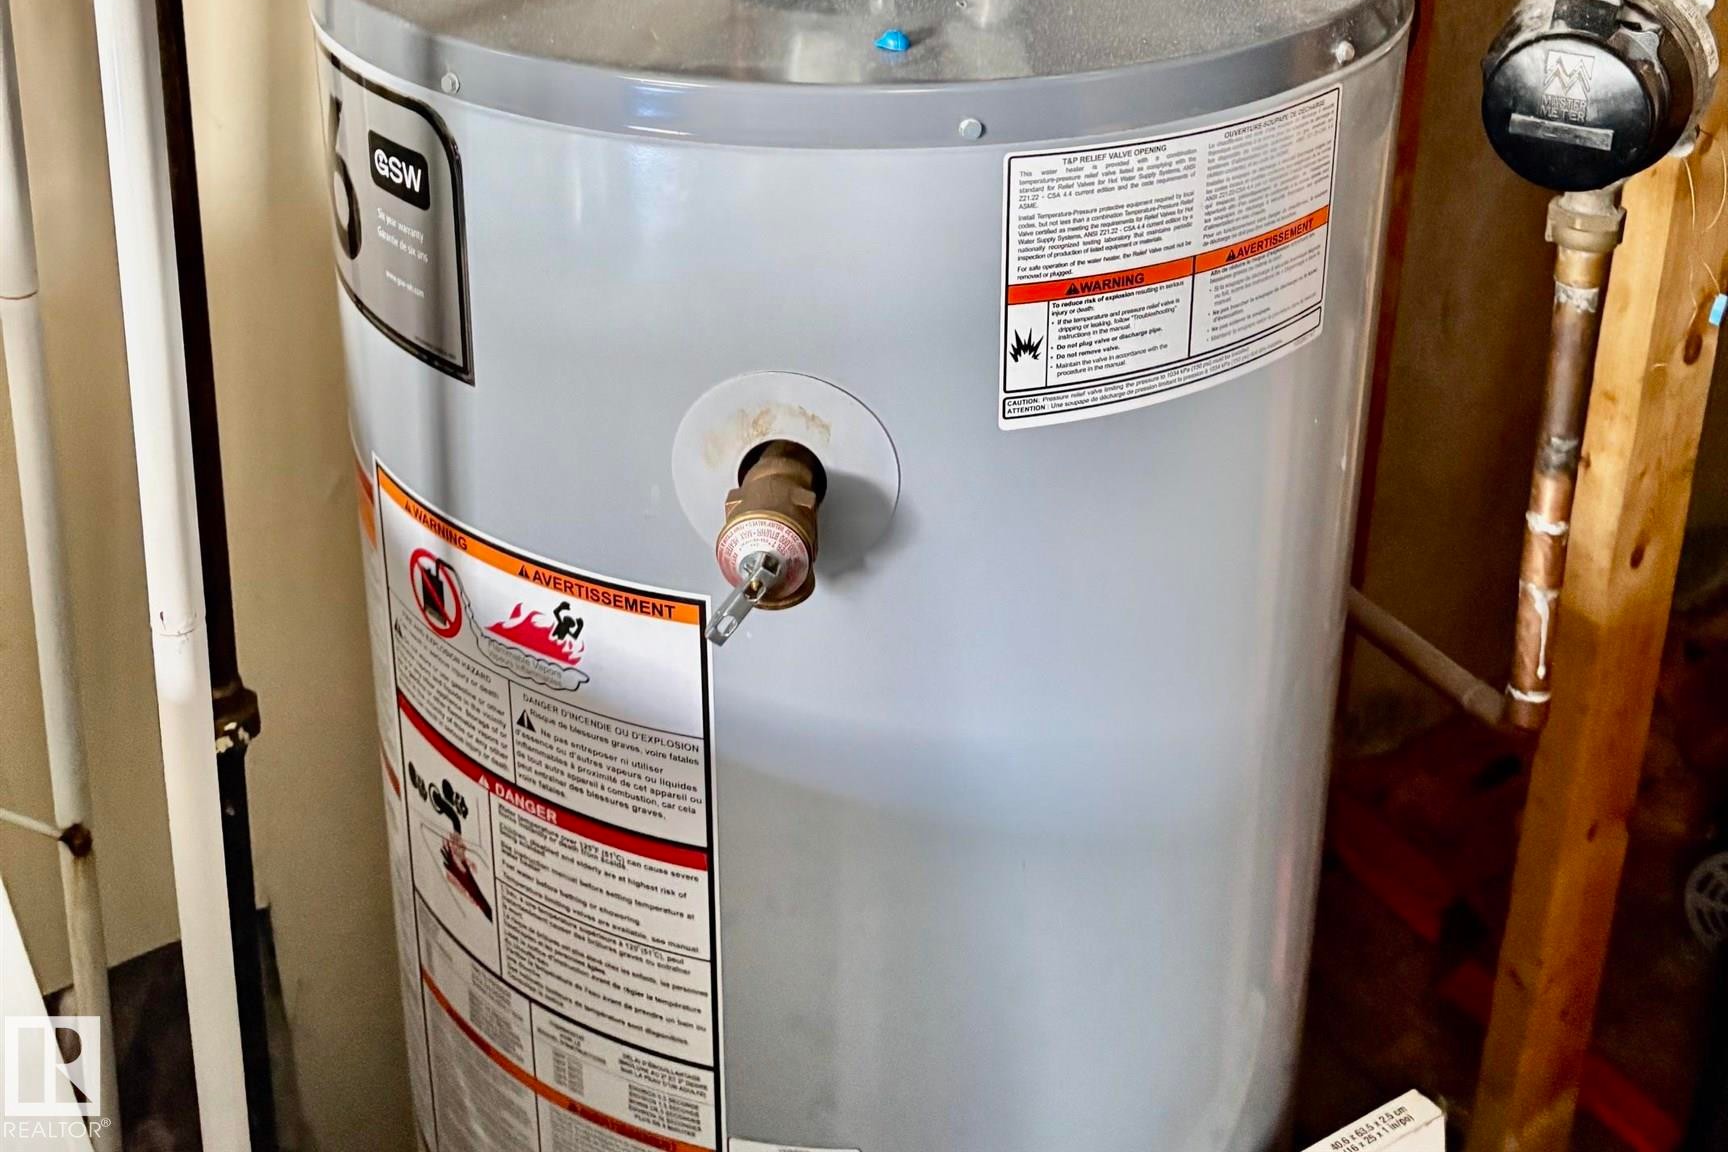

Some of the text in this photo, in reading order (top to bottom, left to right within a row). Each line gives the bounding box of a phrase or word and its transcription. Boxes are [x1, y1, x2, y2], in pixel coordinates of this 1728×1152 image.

[1542, 95, 1586, 110] MASTER
[1541, 105, 1585, 122] METER
[1062, 145, 1166, 165] T&P RELIEF VALVE OPENING
[374, 148, 422, 192] GSW
[398, 222, 424, 243] warranty
[1237, 219, 1314, 258] AVERTISSEMENT
[1018, 248, 1082, 261] inspection production
[1017, 269, 1073, 280] removed plugged.
[1042, 261, 1068, 270] operation
[1079, 274, 1144, 293] WARNING
[1105, 291, 1134, 301] explosion
[1136, 286, 1158, 295] resulting
[1058, 324, 1082, 333] dripping
[1091, 320, 1112, 328] leaking,
[1114, 316, 1130, 324] follow
[1131, 306, 1177, 320] "Troubleshooting"
[1073, 313, 1108, 323] temperature
[1122, 306, 1145, 315] pressure
[1058, 331, 1091, 340] instructions
[1079, 339, 1092, 347] plug
[1119, 330, 1147, 340] discharge
[1149, 327, 1162, 335] pipe.
[1056, 361, 1080, 369] Maintain
[1115, 348, 1146, 358] accordance
[1148, 345, 1159, 353] with
[1079, 348, 1100, 356] remove
[1057, 368, 1086, 377] procedure
[1042, 392, 1069, 401] Pressure
[1136, 377, 1159, 386] pressure
[1008, 405, 1045, 414] ATTENTION
[413, 507, 468, 550] WARNING
[532, 570, 675, 619] AVERTISSEMENT
[523, 693, 699, 752] DANGER D'INCENDIE OU D'EXPLOSION
[530, 709, 699, 766] Risque de blessures voire fatales
[515, 729, 697, 792] d'essence ou d'autres vapeurs ou liquides
[541, 728, 664, 774] Ne pas entreposer ni utiliser
[516, 739, 702, 804] inflammables proximité de cet appareil ou
[518, 773, 537, 785] voire
[517, 750, 696, 814] de tout autre appareil combustion, car cela
[517, 761, 629, 809] peut des blessures
[495, 784, 558, 824] DANGER
[577, 859, 675, 896] elderly highest risk
[626, 859, 699, 882] can cause severe
[536, 875, 558, 893] before
[579, 880, 689, 918] before setting temperature
[672, 983, 708, 997] personnes
[634, 1004, 668, 1021] prendre
[655, 995, 701, 1013] température
[1331, 1137, 1350, 1150] 40.6
[1354, 1124, 1374, 1137] 63.5
[1379, 1113, 1394, 1122] 2.5
[1394, 1106, 1407, 1115] cm
[1364, 1134, 1376, 1144] 25
